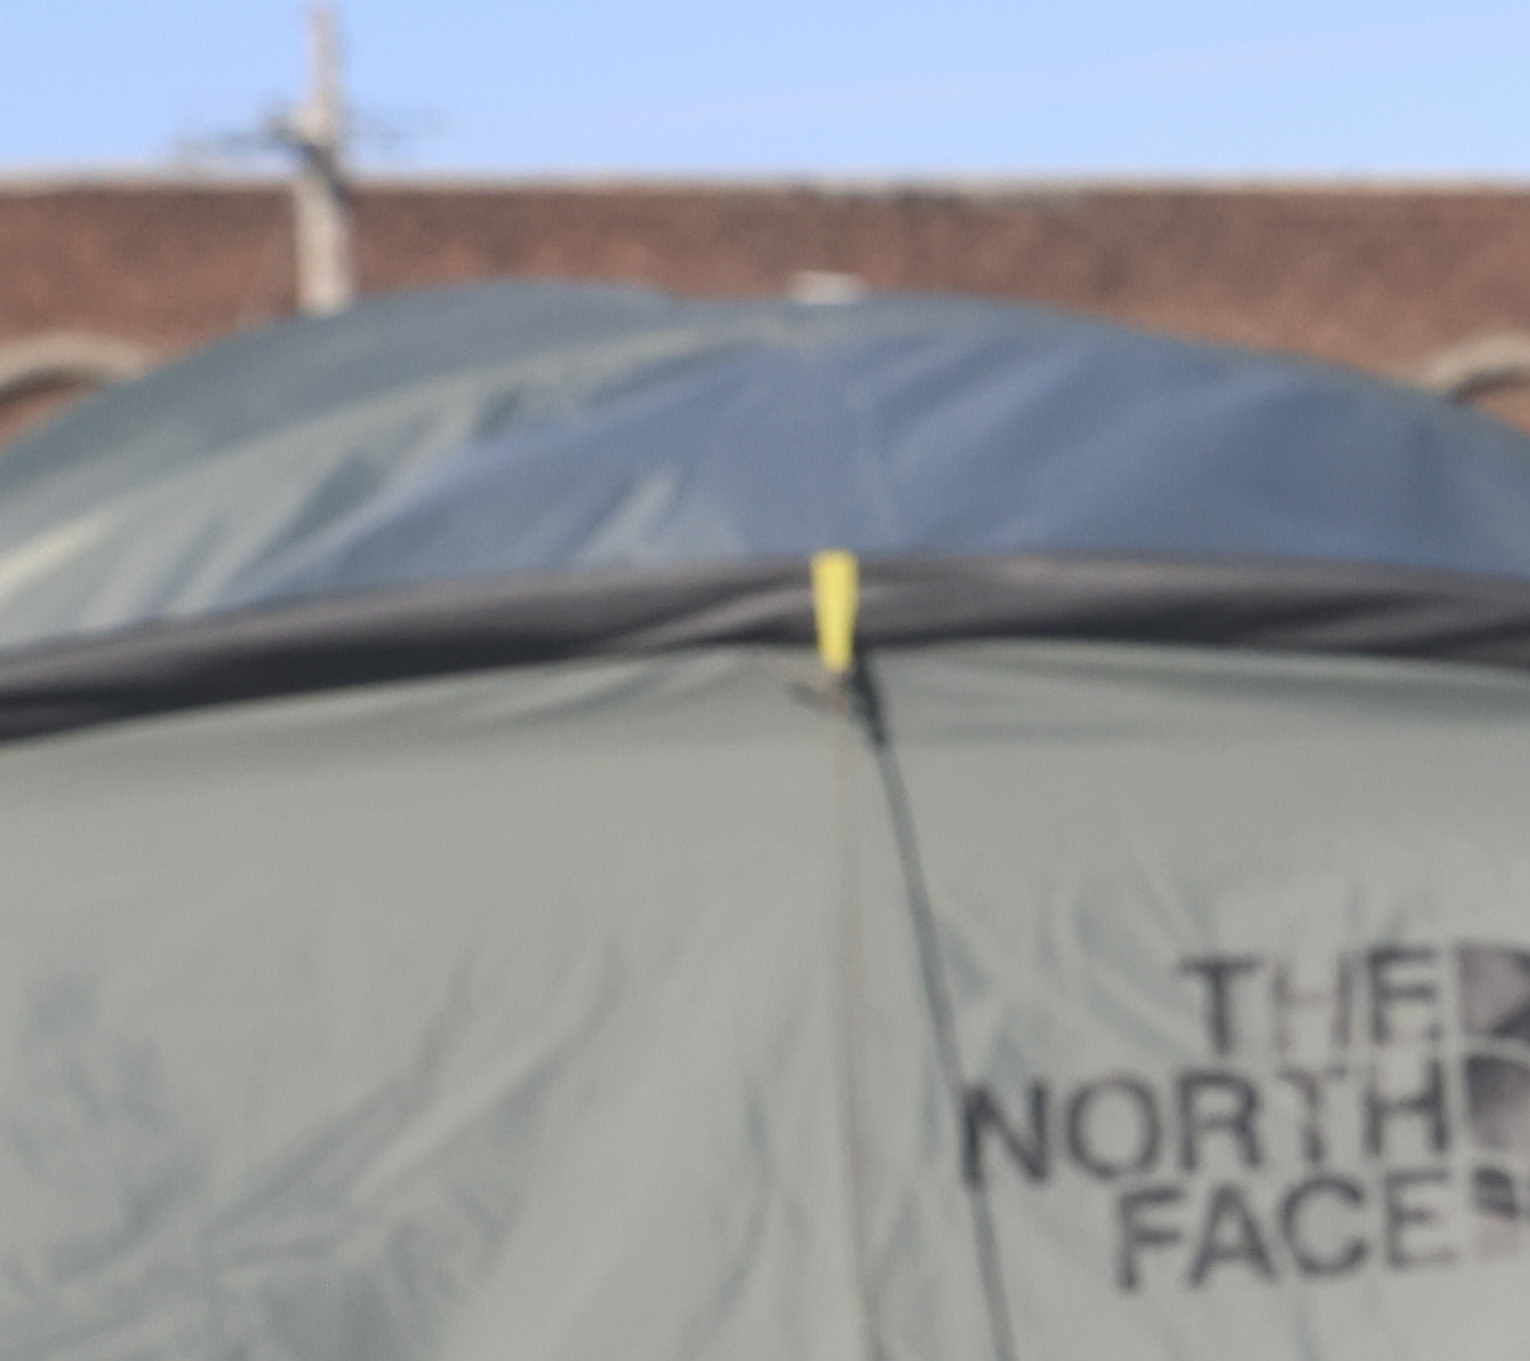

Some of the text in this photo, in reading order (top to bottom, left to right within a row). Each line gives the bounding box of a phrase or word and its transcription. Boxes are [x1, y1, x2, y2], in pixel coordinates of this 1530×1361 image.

[1179, 945, 1439, 1055] THE
[958, 1055, 1452, 1187] NORTH
[1114, 1168, 1456, 1292] FACE
